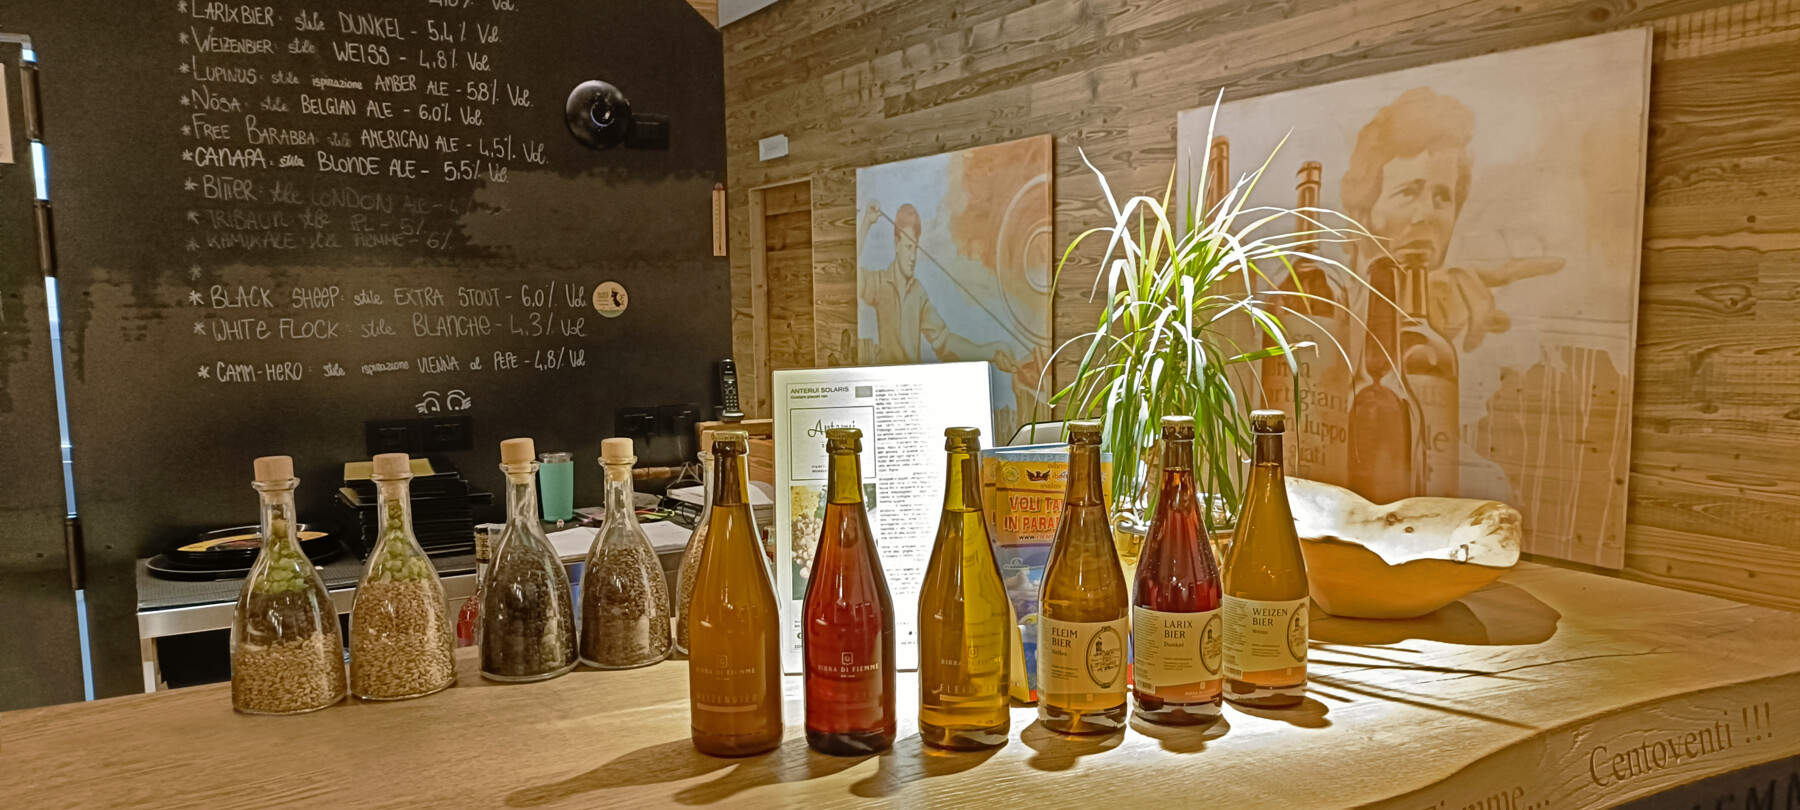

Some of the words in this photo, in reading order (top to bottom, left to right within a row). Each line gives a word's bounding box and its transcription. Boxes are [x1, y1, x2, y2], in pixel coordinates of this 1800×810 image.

[295, 10, 325, 31] stile
[338, 11, 405, 40] DUNKEL
[288, 37, 316, 54] stile
[333, 42, 390, 66] WEISS
[375, 74, 417, 92] AMBER
[427, 80, 449, 97] ALE
[301, 94, 357, 116] BELGIAN
[367, 99, 394, 119] ALE
[193, 113, 231, 140] FREE
[361, 128, 429, 150] AMERICAN
[435, 135, 460, 153] ALE
[317, 150, 380, 176] BLONDE
[390, 158, 416, 179] ALE
[311, 186, 393, 214] LONDON
[210, 285, 273, 309] BLACK
[353, 290, 384, 306] stile
[394, 287, 444, 308] EXTRA
[458, 286, 500, 308] STOUT
[212, 318, 272, 341] WHITE
[361, 317, 396, 338] stile
[412, 311, 491, 338] BLANCHE
[417, 354, 460, 374] VIENNA
[494, 350, 519, 371] PEPE
[1009, 496, 1042, 512] VOLI
[1004, 516, 1019, 531] IN
[1252, 608, 1289, 617] WEIZEN
[1252, 618, 1275, 627] BIER
[1052, 627, 1078, 639] FLEIM
[1164, 620, 1193, 629] LARIX
[1164, 630, 1186, 639] BIER
[1052, 638, 1071, 648] BIER
[851, 663, 880, 673] FIEMME
[1590, 710, 1732, 788] Centoventi
